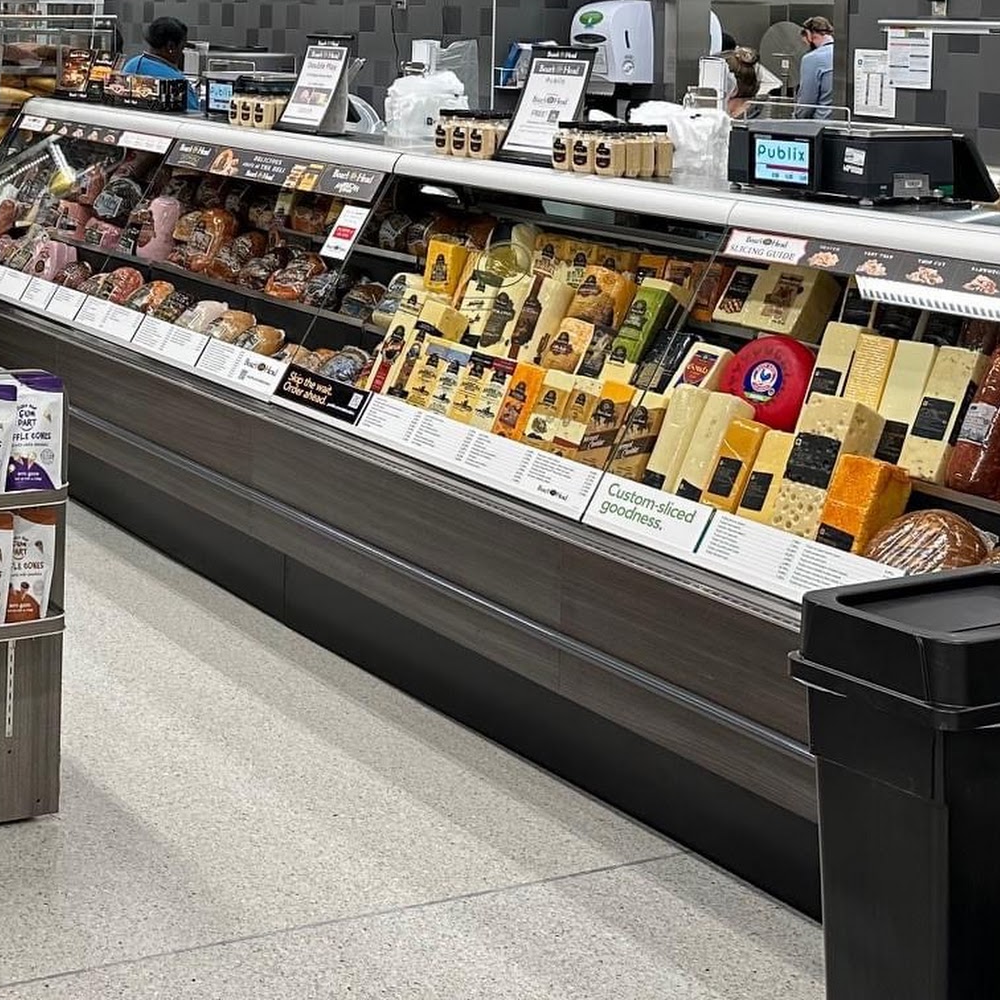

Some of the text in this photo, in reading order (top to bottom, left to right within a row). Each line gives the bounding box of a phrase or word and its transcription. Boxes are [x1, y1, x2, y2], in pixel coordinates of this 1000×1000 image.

[758, 144, 805, 162] Publix
[731, 244, 796, 261] SLICING GUIDE
[283, 381, 304, 397] Order
[288, 371, 304, 387] Skip
[304, 377, 316, 390] the
[18, 410, 36, 418] FUN
[30, 432, 52, 440] CONES
[608, 483, 698, 523] Custom-sliced
[599, 500, 663, 531] goodness.
